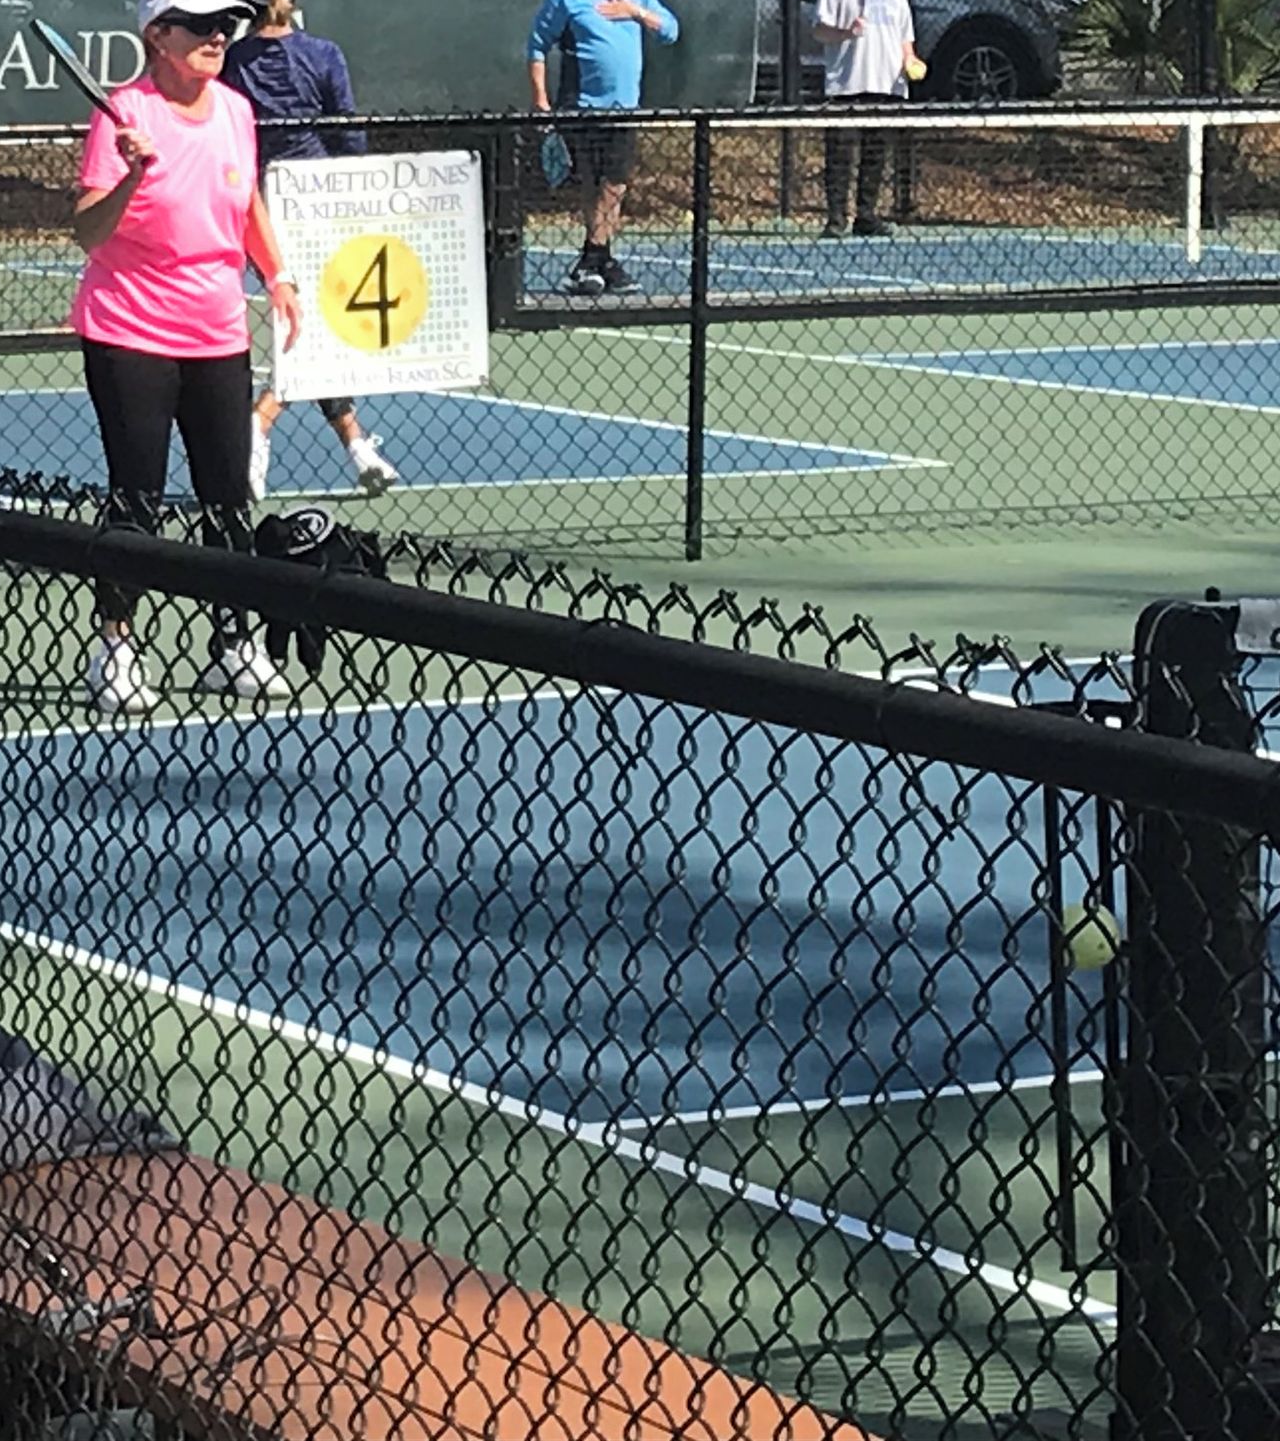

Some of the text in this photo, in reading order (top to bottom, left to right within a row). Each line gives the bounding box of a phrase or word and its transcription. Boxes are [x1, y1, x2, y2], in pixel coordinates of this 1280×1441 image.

[274, 160, 470, 195] PALMETTO DUNES
[282, 191, 463, 221] PIKLEBALL CENTER
[345, 243, 401, 349] 4
